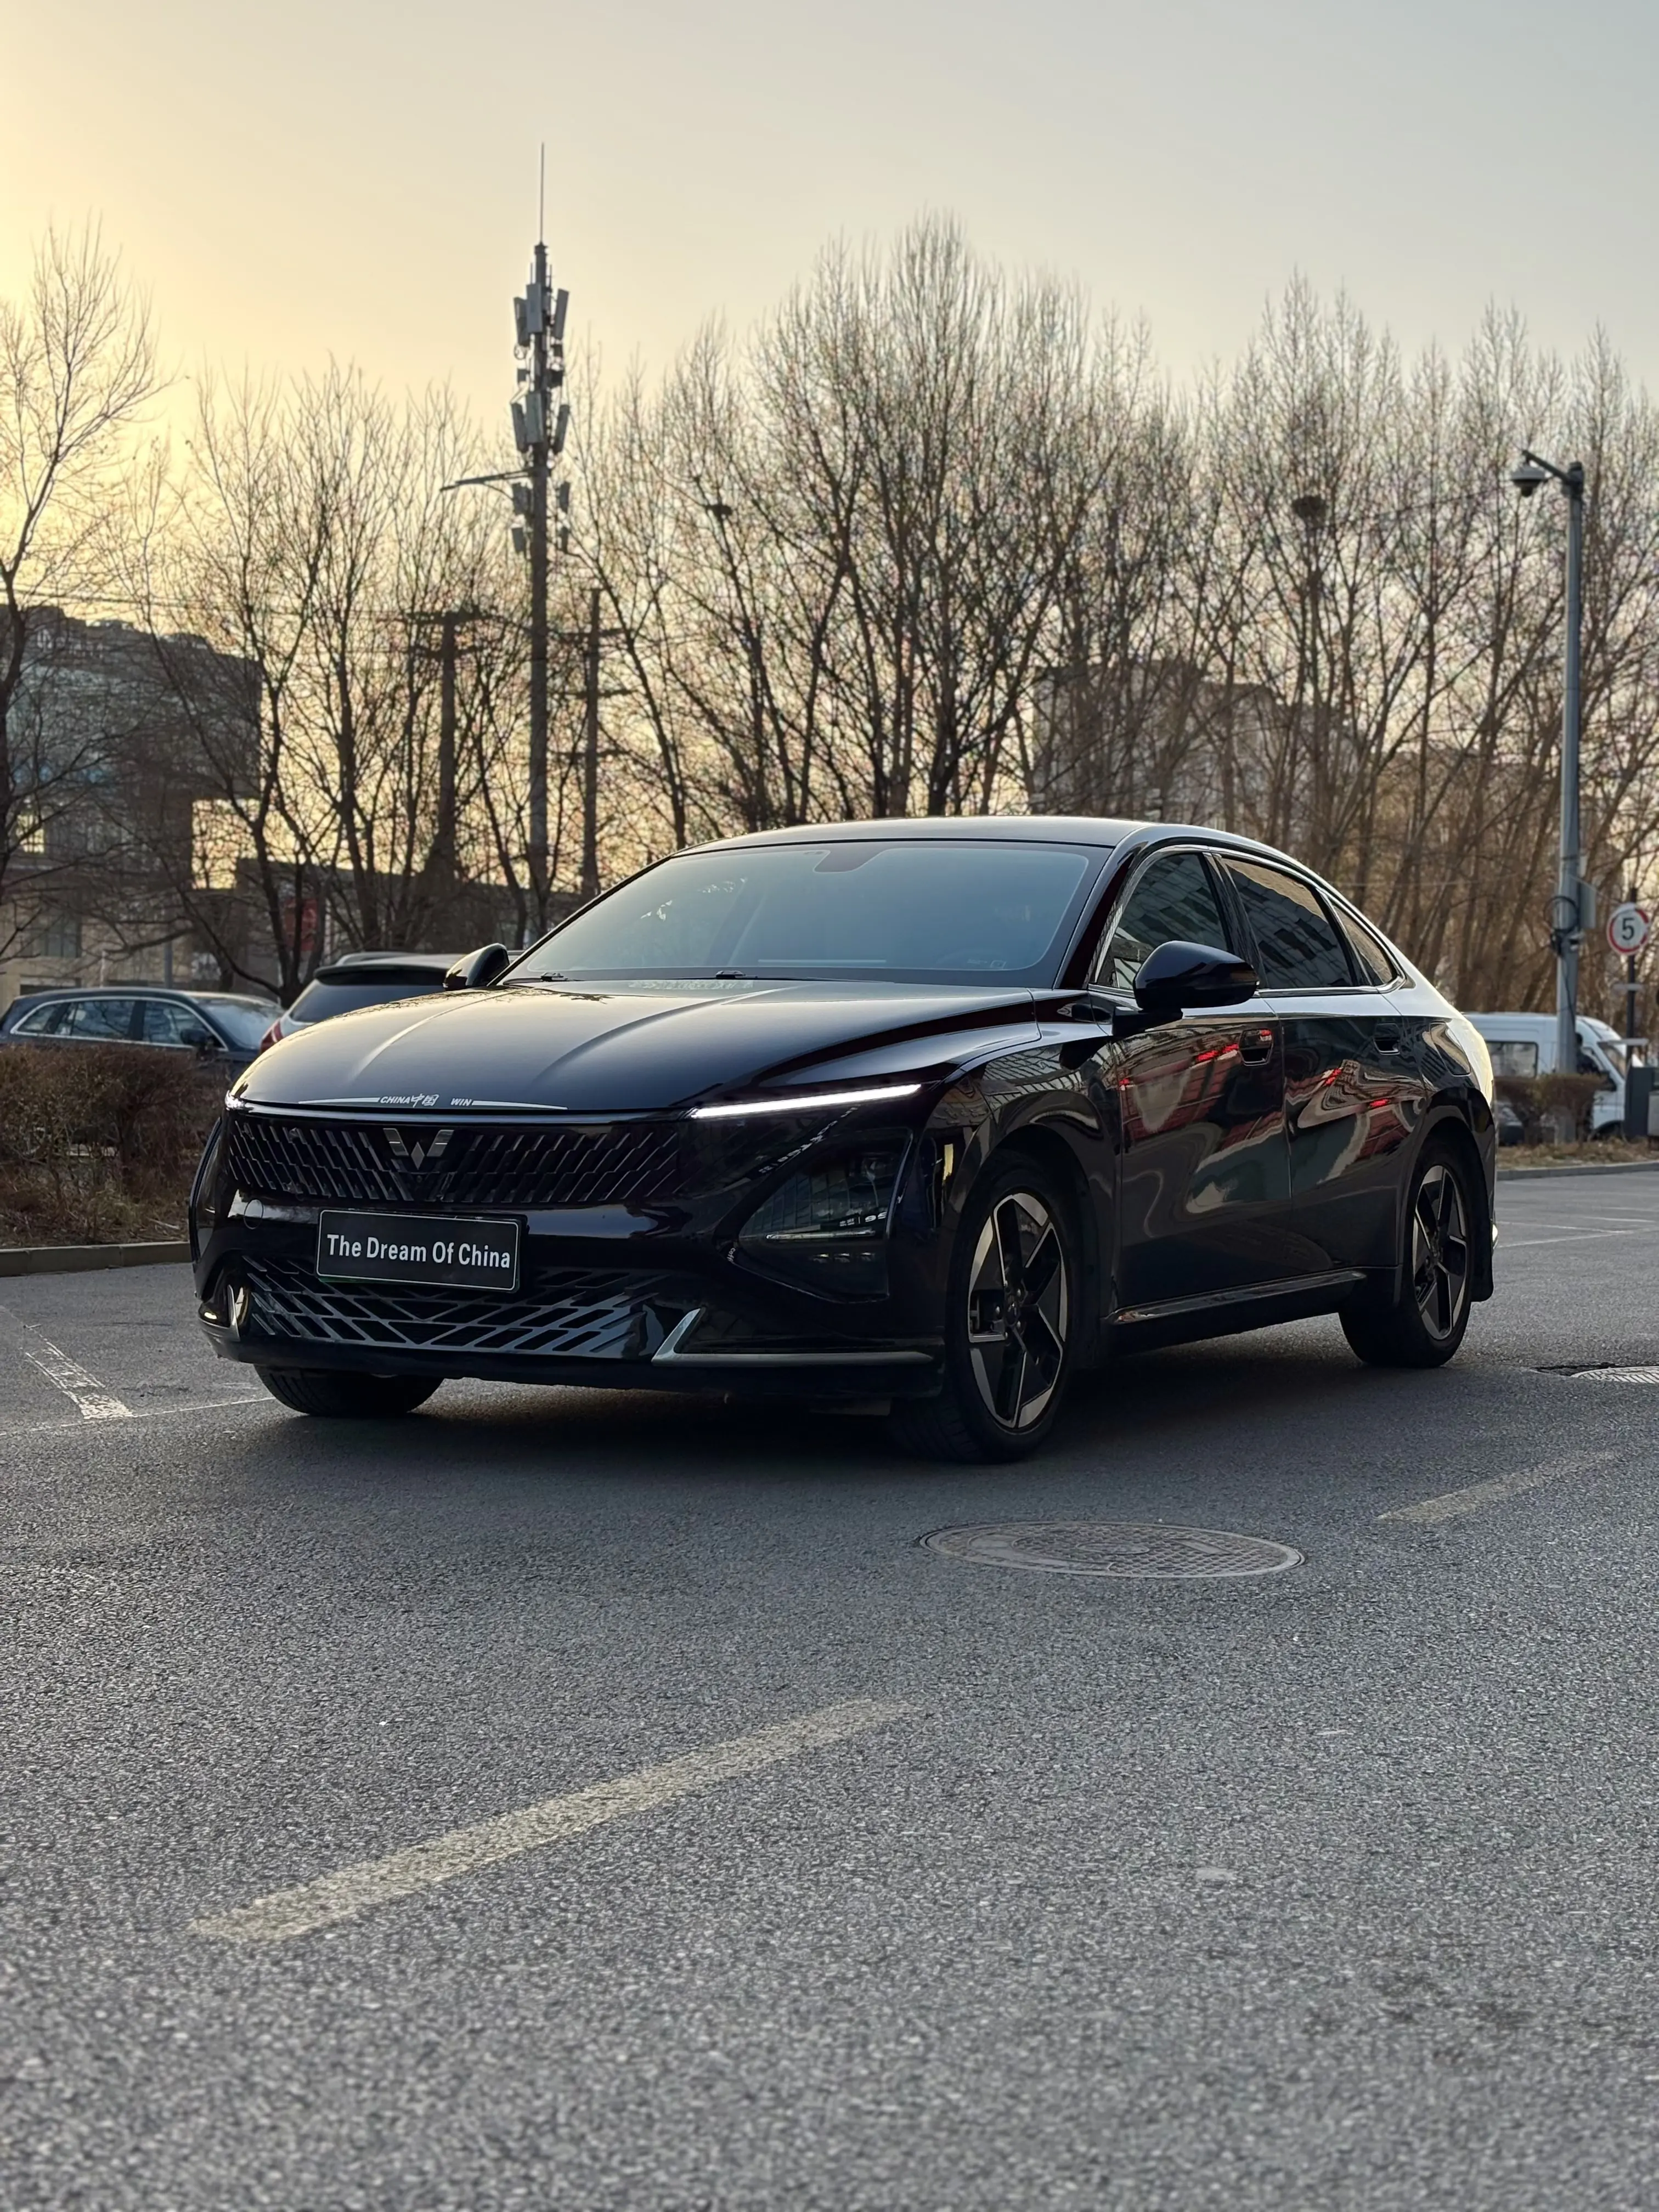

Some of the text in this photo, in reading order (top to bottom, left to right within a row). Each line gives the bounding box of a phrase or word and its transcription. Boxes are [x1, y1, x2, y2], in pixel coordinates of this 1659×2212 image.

[1622, 918, 1634, 940] 5
[450, 1098, 472, 1106] WIN
[327, 1234, 510, 1268] The Dream Of China
